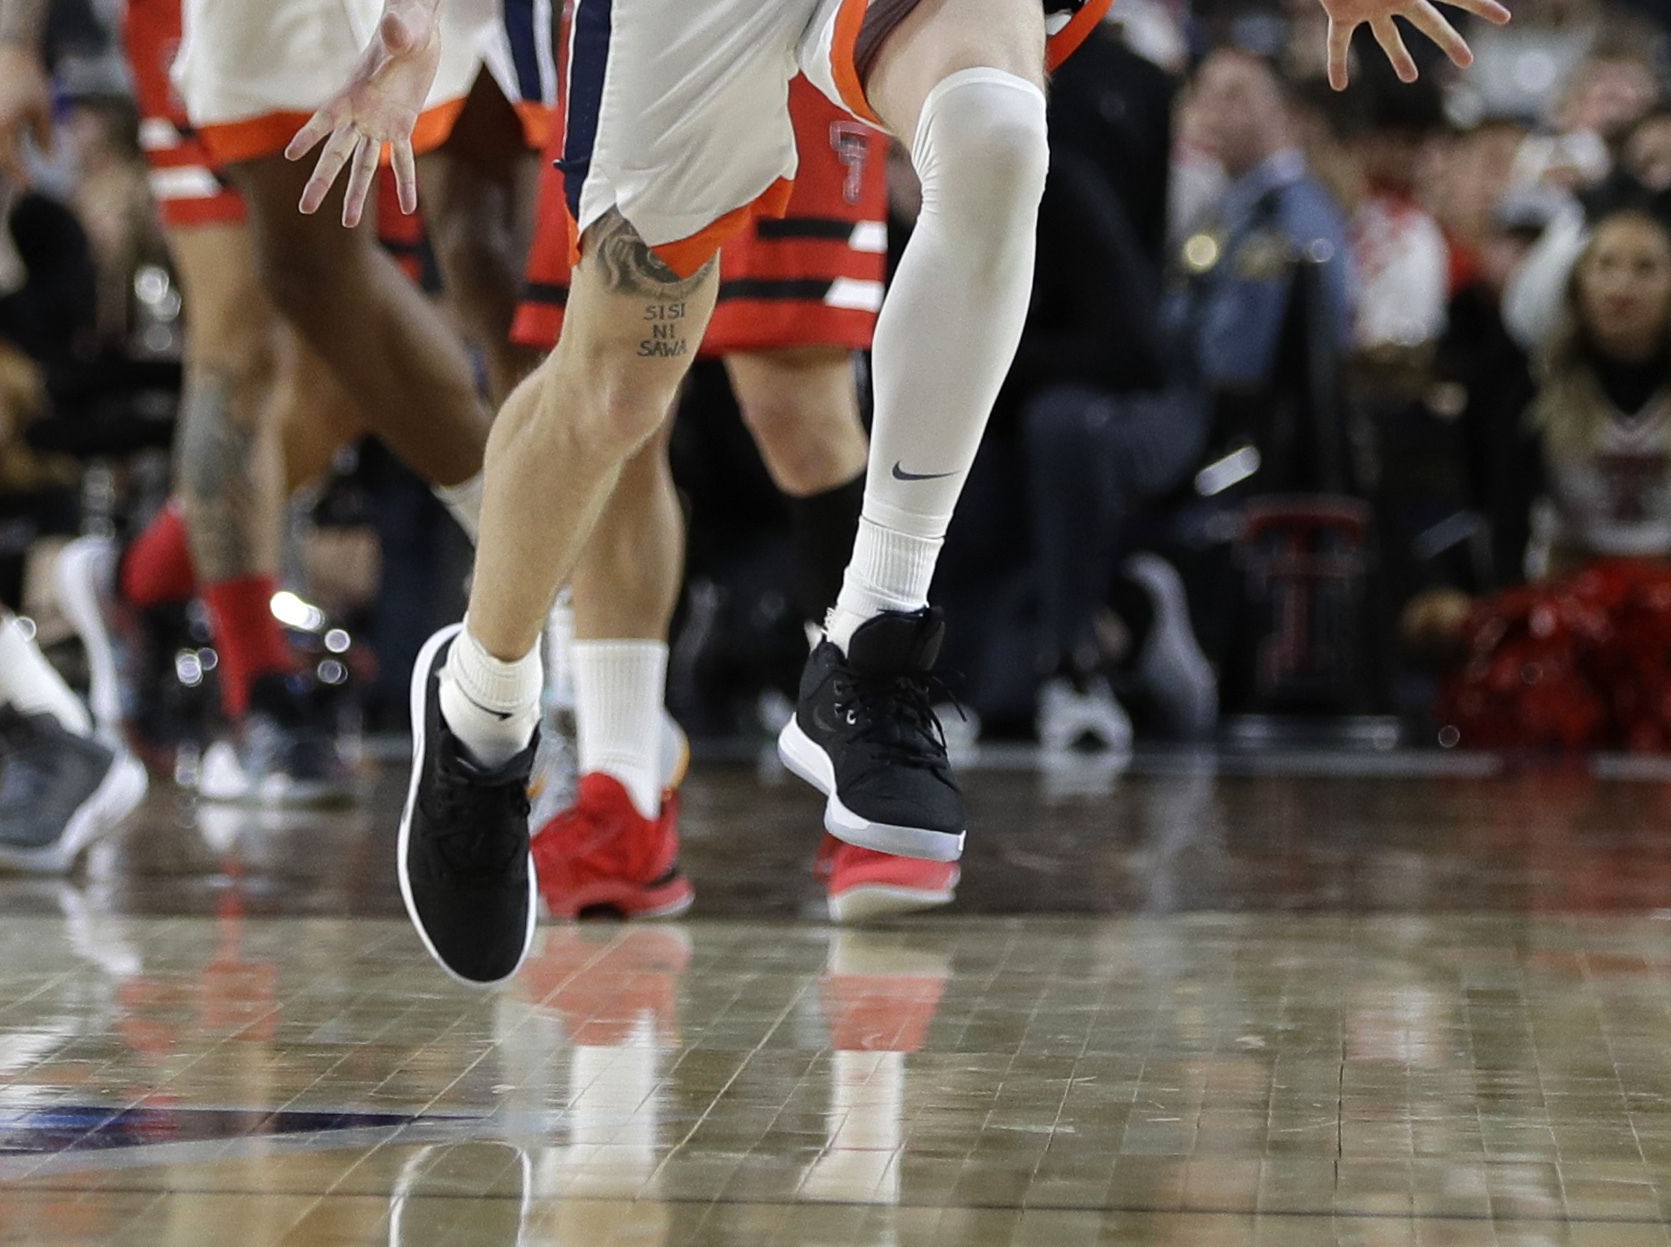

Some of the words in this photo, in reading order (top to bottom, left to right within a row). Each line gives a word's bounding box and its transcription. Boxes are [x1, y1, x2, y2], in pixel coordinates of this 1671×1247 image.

[643, 303, 686, 321] SISI
[653, 324, 675, 339] NI
[637, 339, 688, 357] SAWA
